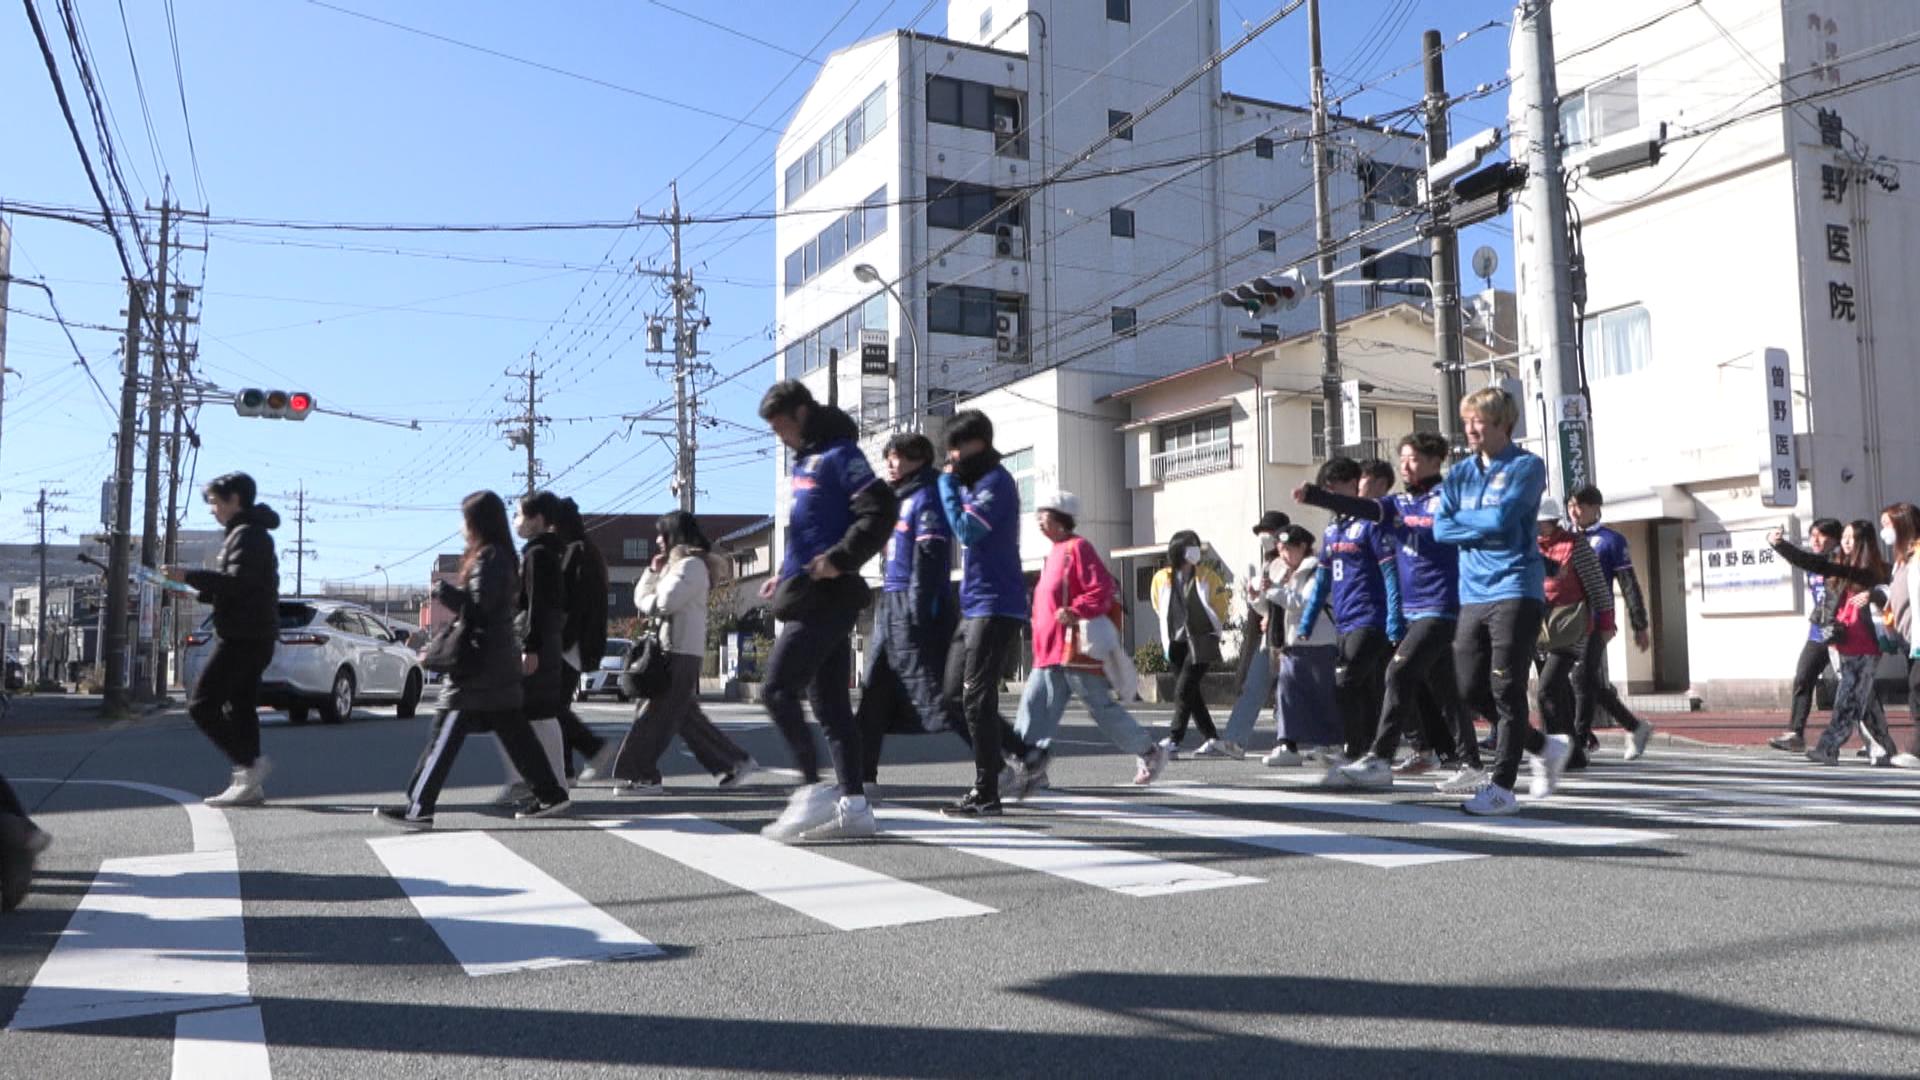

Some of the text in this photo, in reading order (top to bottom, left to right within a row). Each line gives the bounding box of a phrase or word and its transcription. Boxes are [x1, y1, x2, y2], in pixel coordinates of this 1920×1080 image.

[1771, 365, 1792, 491] 曽野医院
[1708, 547, 1776, 569] 曽野医院
[1332, 559, 1344, 581] 8
